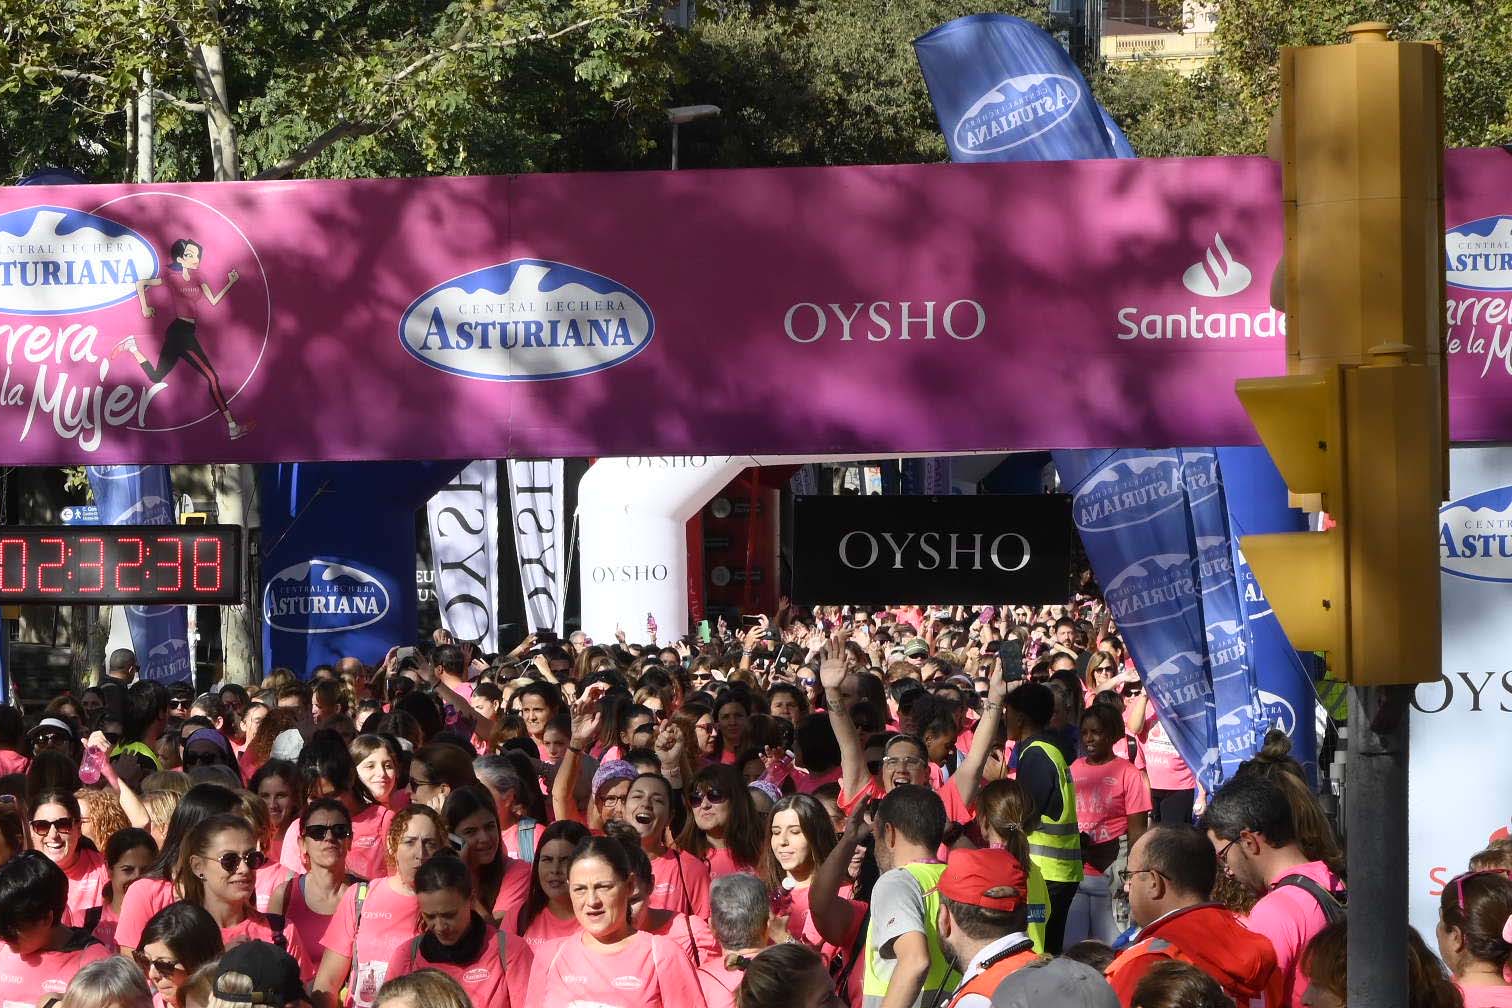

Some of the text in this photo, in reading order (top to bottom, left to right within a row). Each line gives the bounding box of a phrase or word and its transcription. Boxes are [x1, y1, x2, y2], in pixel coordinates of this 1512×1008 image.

[419, 306, 635, 350] ASTURIANA
[458, 300, 625, 315] CENTRAL LECHERA
[784, 299, 986, 343] OYSHO
[1117, 306, 1286, 340] Santande
[0, 367, 24, 406] la
[20, 358, 168, 451] Mujer
[0, 537, 222, 592] 02:32:38
[838, 530, 1031, 571] OYSHO
[592, 564, 668, 584] OYSHO
[267, 589, 380, 617] ASTURIANA
